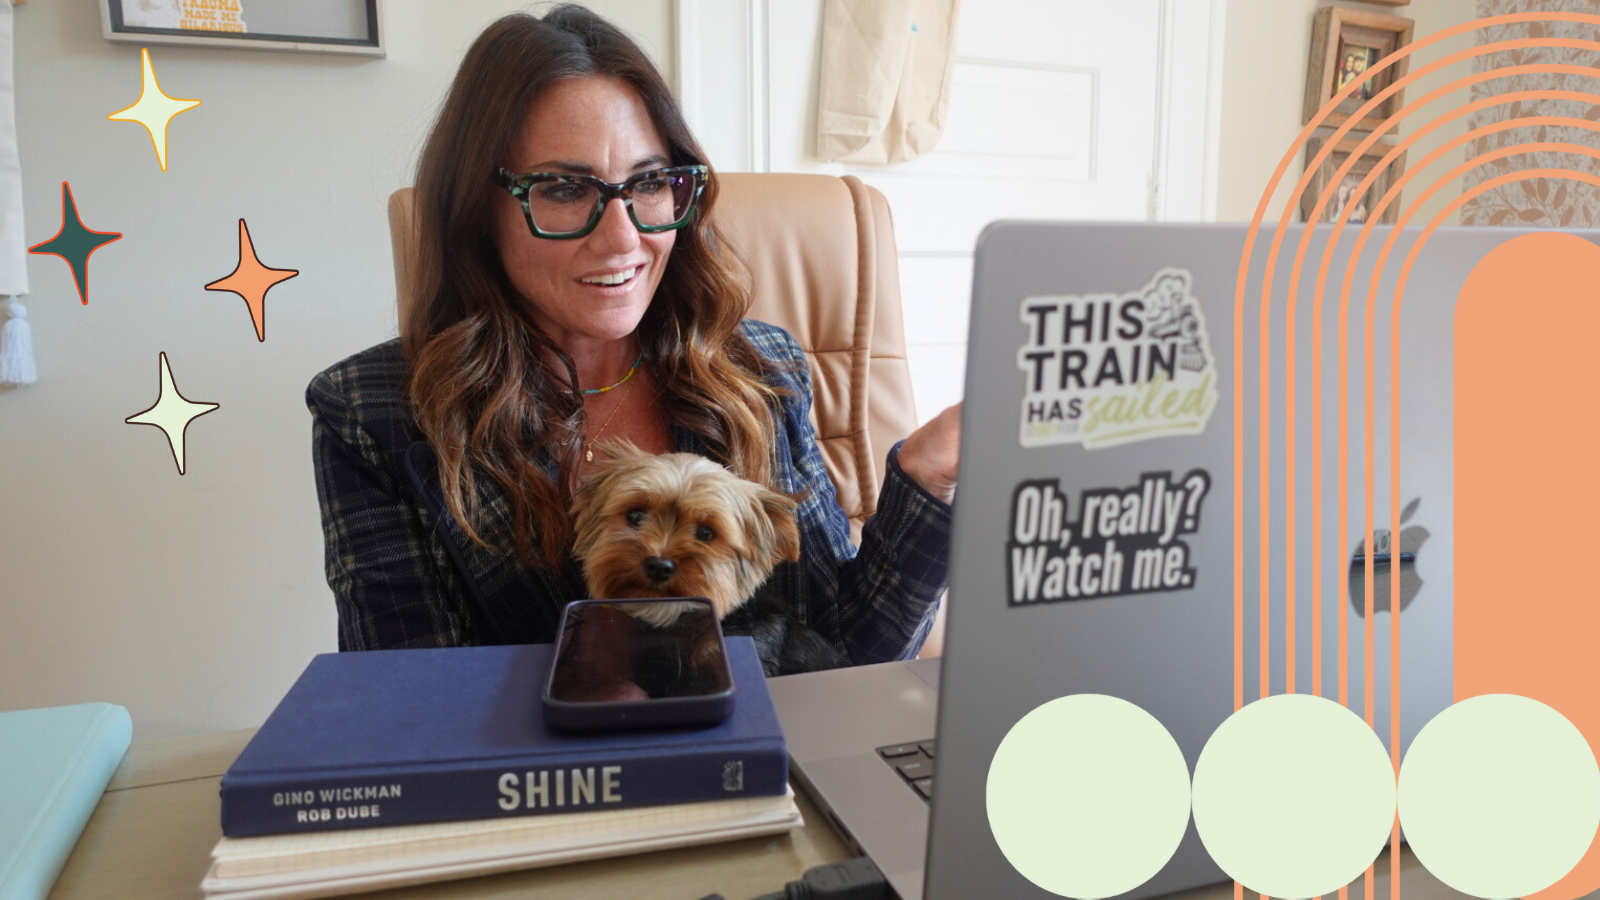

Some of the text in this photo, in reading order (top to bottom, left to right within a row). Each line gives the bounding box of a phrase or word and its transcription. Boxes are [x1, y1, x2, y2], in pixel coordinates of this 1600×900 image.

[179, 19, 244, 33] HILARIOUS
[184, 9, 239, 22] MADE ME
[1027, 299, 1145, 346] THIS
[1024, 343, 1178, 392] TRAIN
[1027, 369, 1212, 433] HAS sailed
[1014, 475, 1206, 549] Oh, really?
[1011, 539, 1191, 602] Watch me.
[273, 784, 402, 806] GINO WICKMAN
[498, 765, 622, 811] SHINE
[297, 804, 381, 823] ROB DUBE
